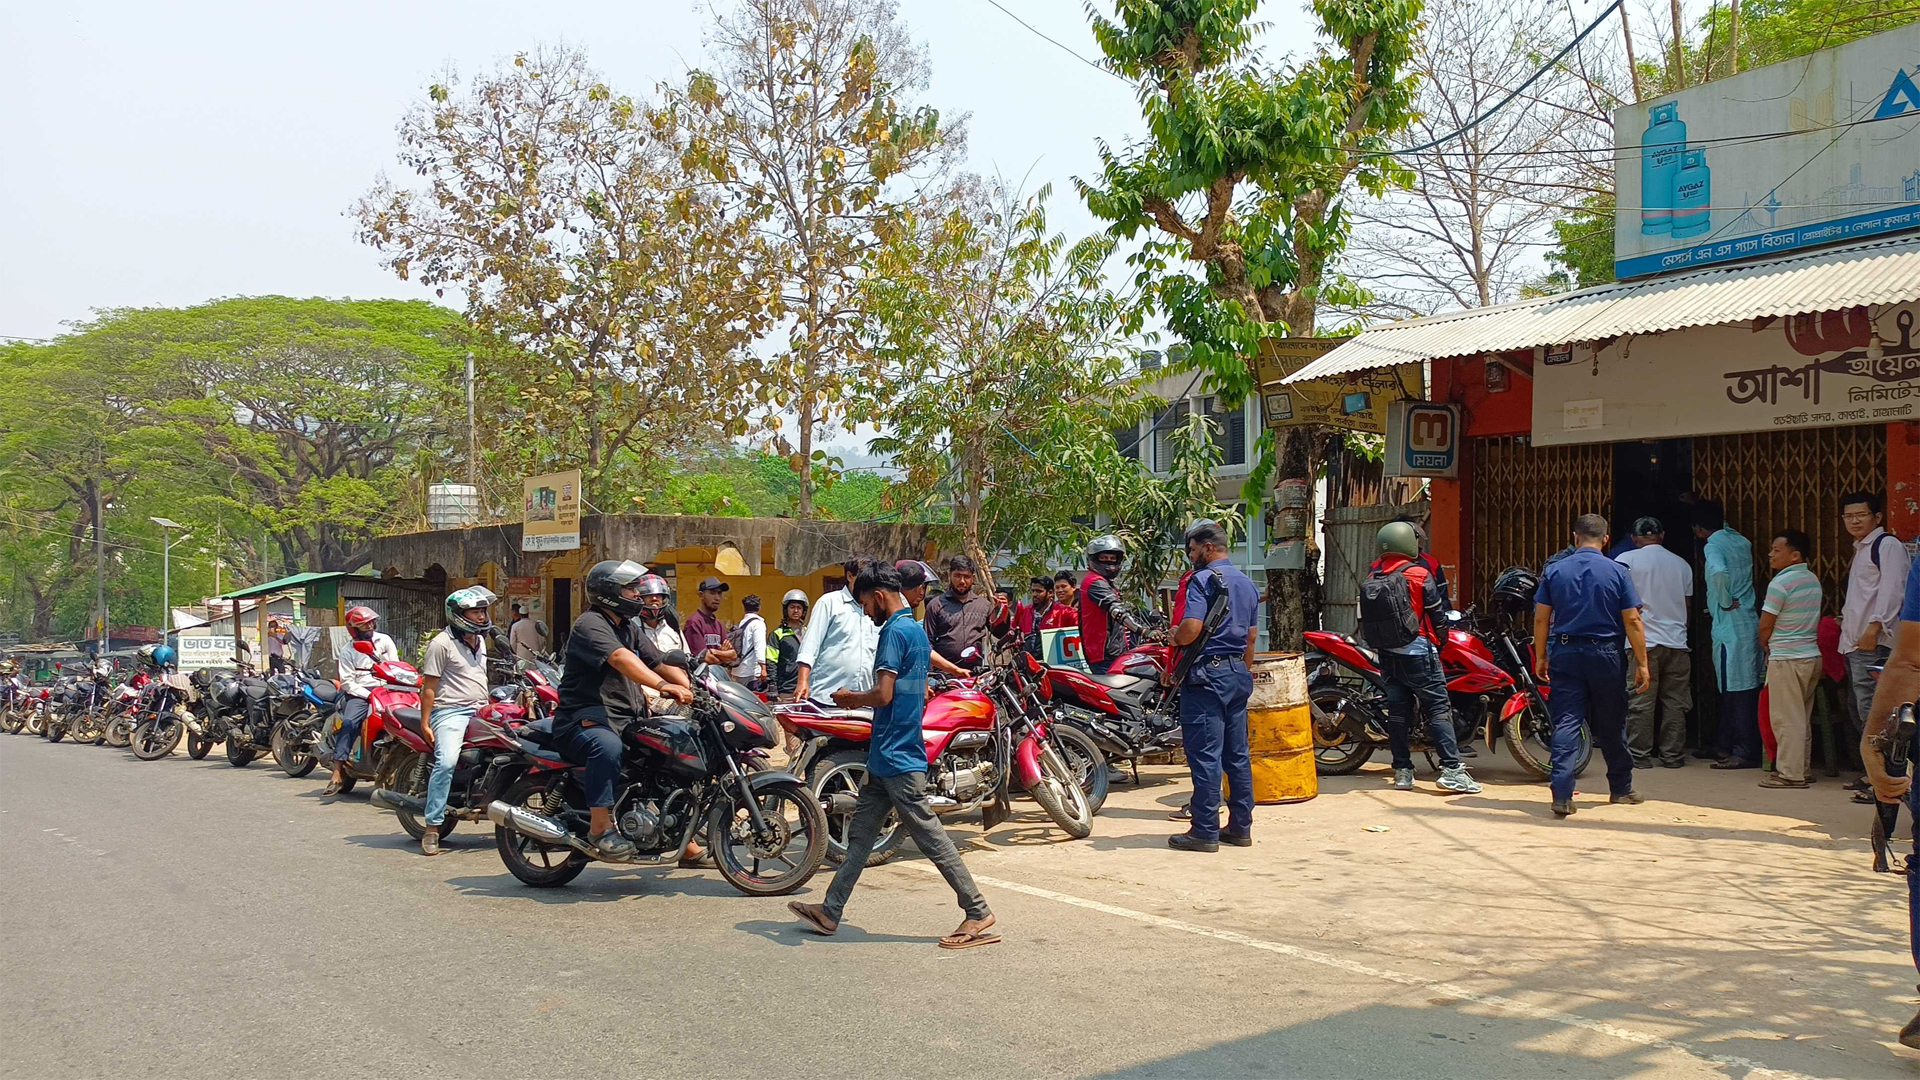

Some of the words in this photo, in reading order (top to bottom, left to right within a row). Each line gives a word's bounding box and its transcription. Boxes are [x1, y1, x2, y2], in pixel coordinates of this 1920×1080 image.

[1678, 180, 1704, 192] AYGAZ
[1695, 248, 1712, 260] এন
[1715, 244, 1731, 256] এস
[1736, 239, 1758, 252] গ্যাস
[1761, 233, 1795, 249] বিতান
[1852, 219, 1881, 232] নেপাল
[1883, 213, 1910, 228] কুমার
[1723, 358, 1820, 405] আশা
[1413, 454, 1447, 468] মেঘনা
[183, 638, 212, 649] ভাত
